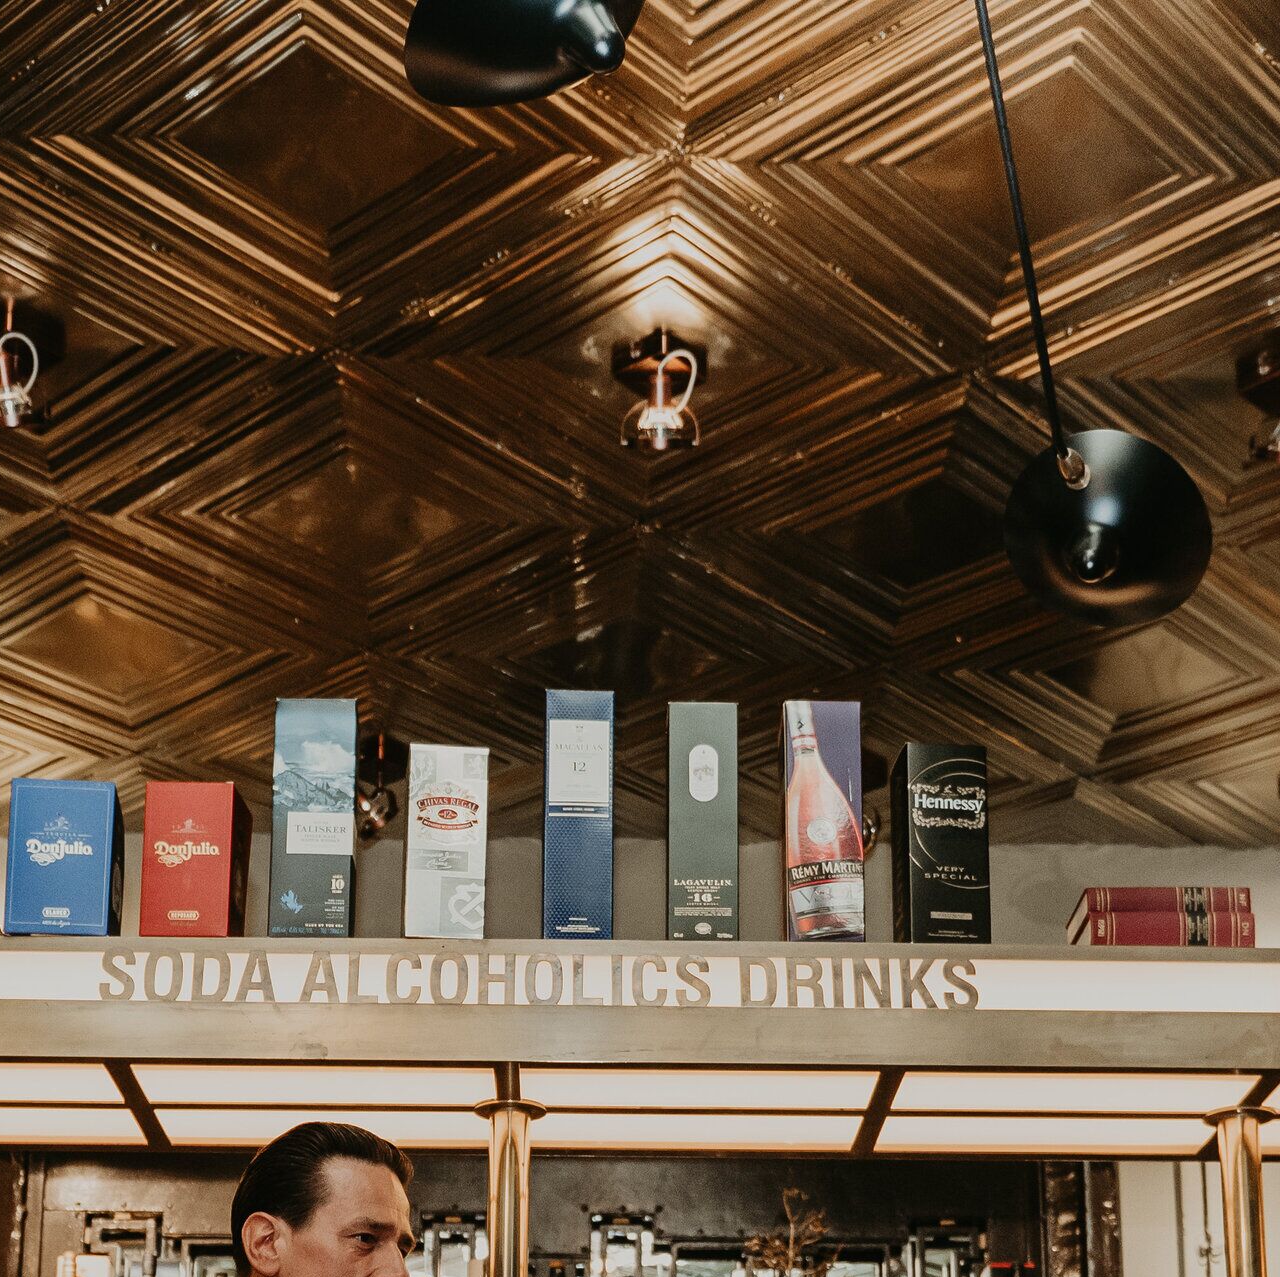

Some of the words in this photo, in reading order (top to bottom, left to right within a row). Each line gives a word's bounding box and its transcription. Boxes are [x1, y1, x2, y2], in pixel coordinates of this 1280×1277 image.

[573, 761, 586, 772] 12
[418, 798, 449, 807] CHIVAS
[450, 799, 478, 812] REGAL
[914, 793, 984, 814] Hennessy
[295, 824, 347, 834] TALISKER
[936, 865, 966, 873] VERY
[924, 872, 978, 881] SPECIAL
[330, 879, 345, 890] 10
[98, 947, 276, 1003] SODA
[299, 950, 711, 1007] ALCOHOLICS
[739, 955, 980, 1010] DRINKS
